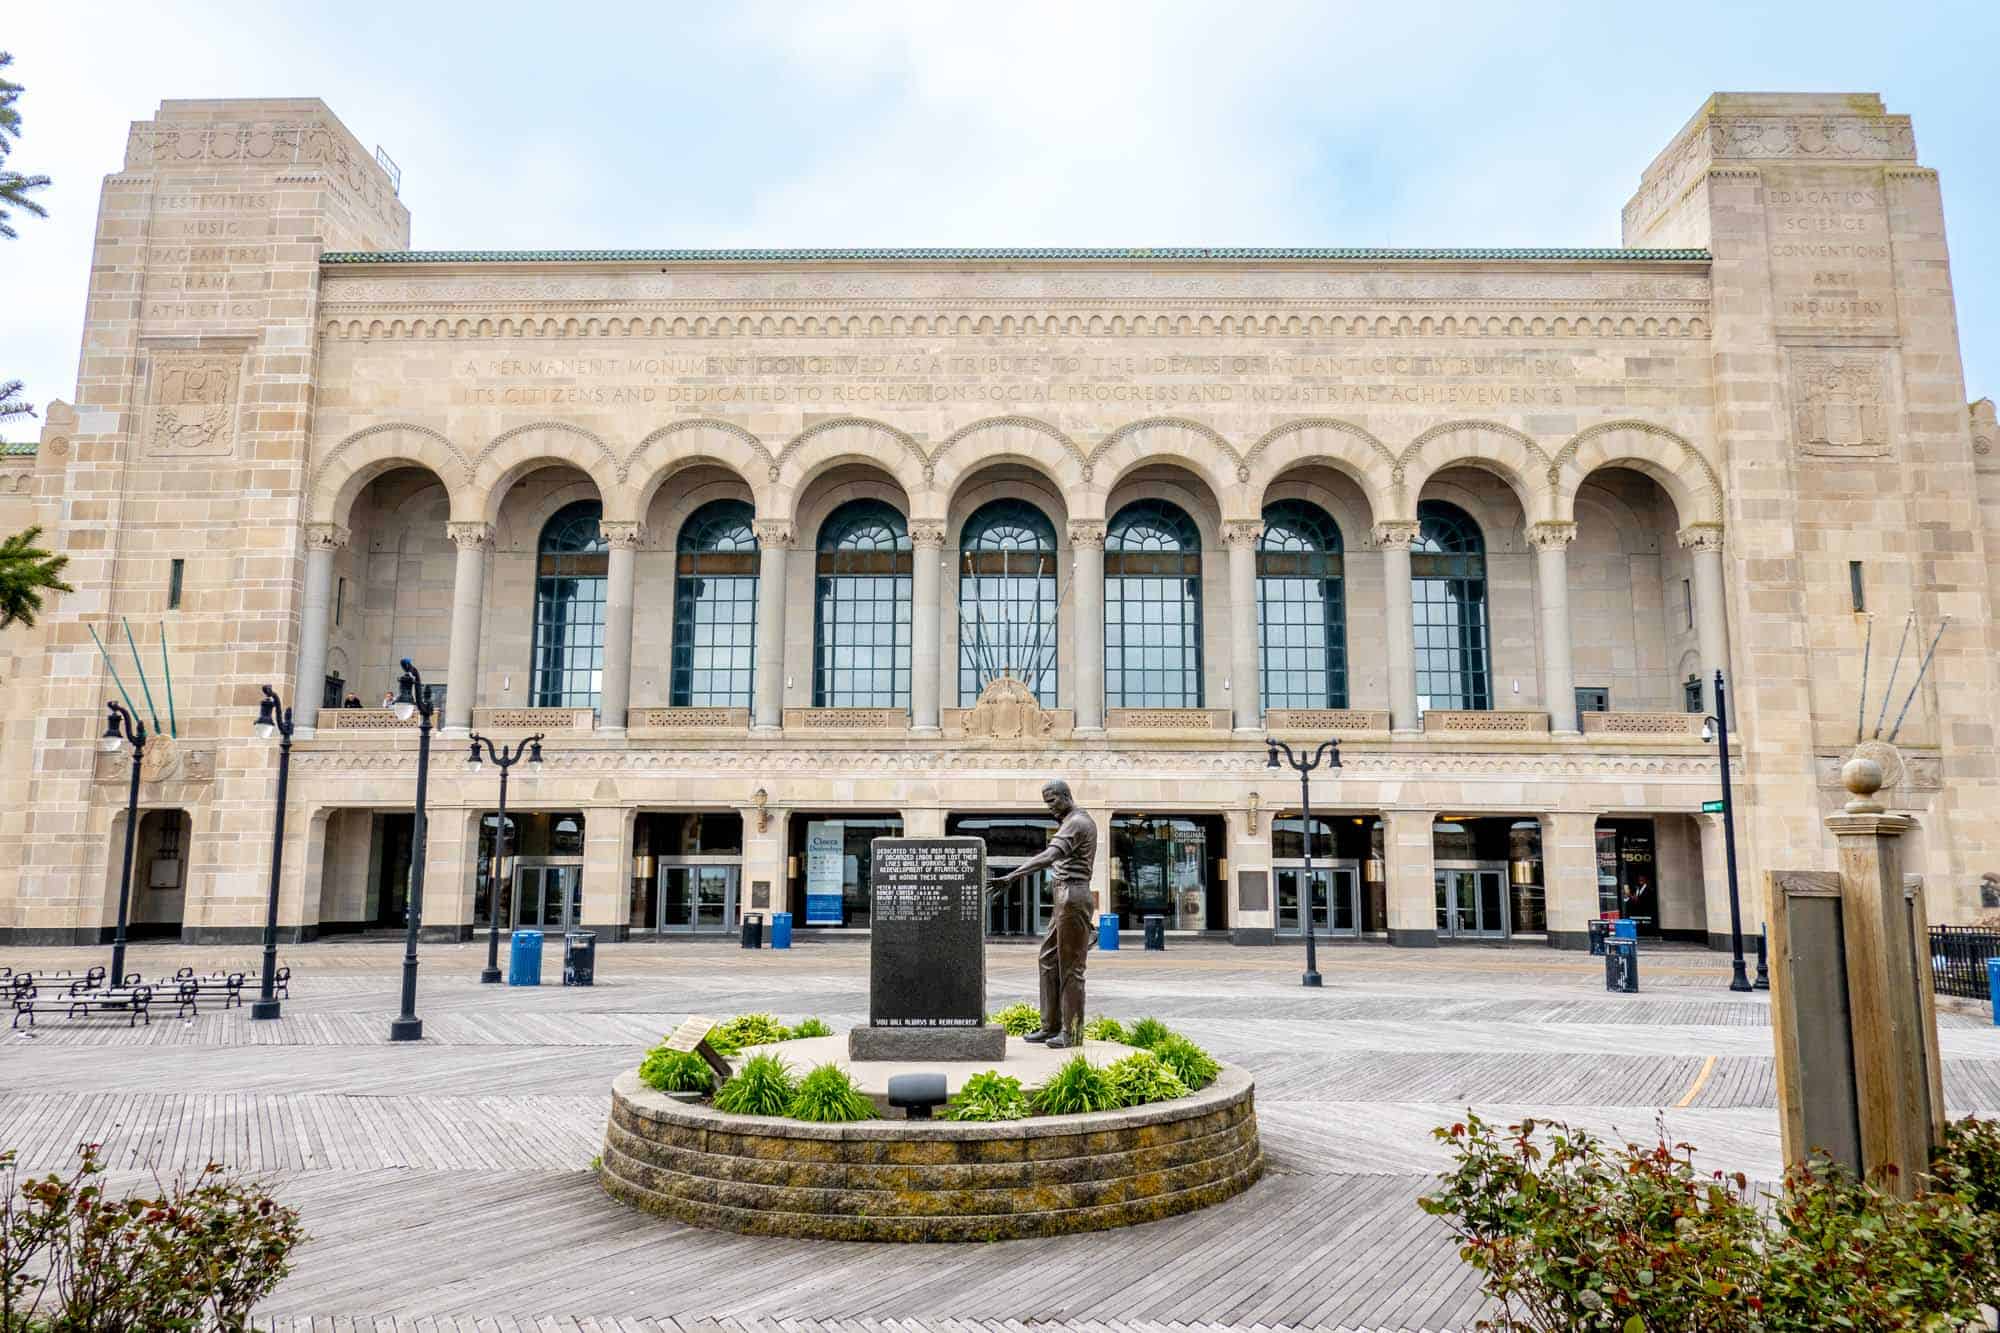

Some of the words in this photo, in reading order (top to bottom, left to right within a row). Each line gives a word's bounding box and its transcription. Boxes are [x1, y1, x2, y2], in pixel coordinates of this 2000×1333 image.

[160, 195, 265, 209] FESTIVITIES
[1770, 191, 1875, 204] EDUCATION
[184, 222, 238, 235] MUSIC
[1784, 217, 1866, 231] SCIENCE
[152, 248, 260, 262] PAGEANTRY
[1772, 245, 1887, 258] CONVENTIONS
[170, 277, 236, 289] DRAMA
[1813, 273, 1849, 286] ART
[151, 303, 255, 317] ATHLETICS
[1783, 301, 1884, 314] INDUSTRY
[464, 359, 478, 375] A
[489, 359, 618, 375] PERMANENT
[629, 359, 748, 375] MONUMENT
[757, 359, 886, 375] CONCEIVED
[896, 359, 921, 375] AS
[928, 359, 943, 375] A
[951, 359, 1041, 375] TRIBUTE
[1052, 359, 1081, 375] TO
[1092, 359, 1137, 375] THE
[1143, 359, 1220, 375] IDEALS
[1231, 359, 1264, 375] OF
[1270, 359, 1386, 375] ATLANTIC
[1395, 359, 1443, 375] CITY
[1459, 359, 1527, 375] BUILT
[1535, 359, 1559, 375] BY
[464, 387, 496, 402] ITS
[505, 387, 607, 402] CITIZENS
[614, 387, 656, 402] AND
[668, 387, 786, 402] DEDICATED
[793, 387, 822, 402] TO
[833, 387, 967, 402] RECREATION
[976, 387, 1056, 402] SOCIAL
[1068, 387, 1180, 402] PROGRESS
[1190, 387, 1233, 402] AND
[1244, 387, 1378, 402] INDUSTRIAL
[1391, 387, 1563, 402] ACHIEVEMENTS
